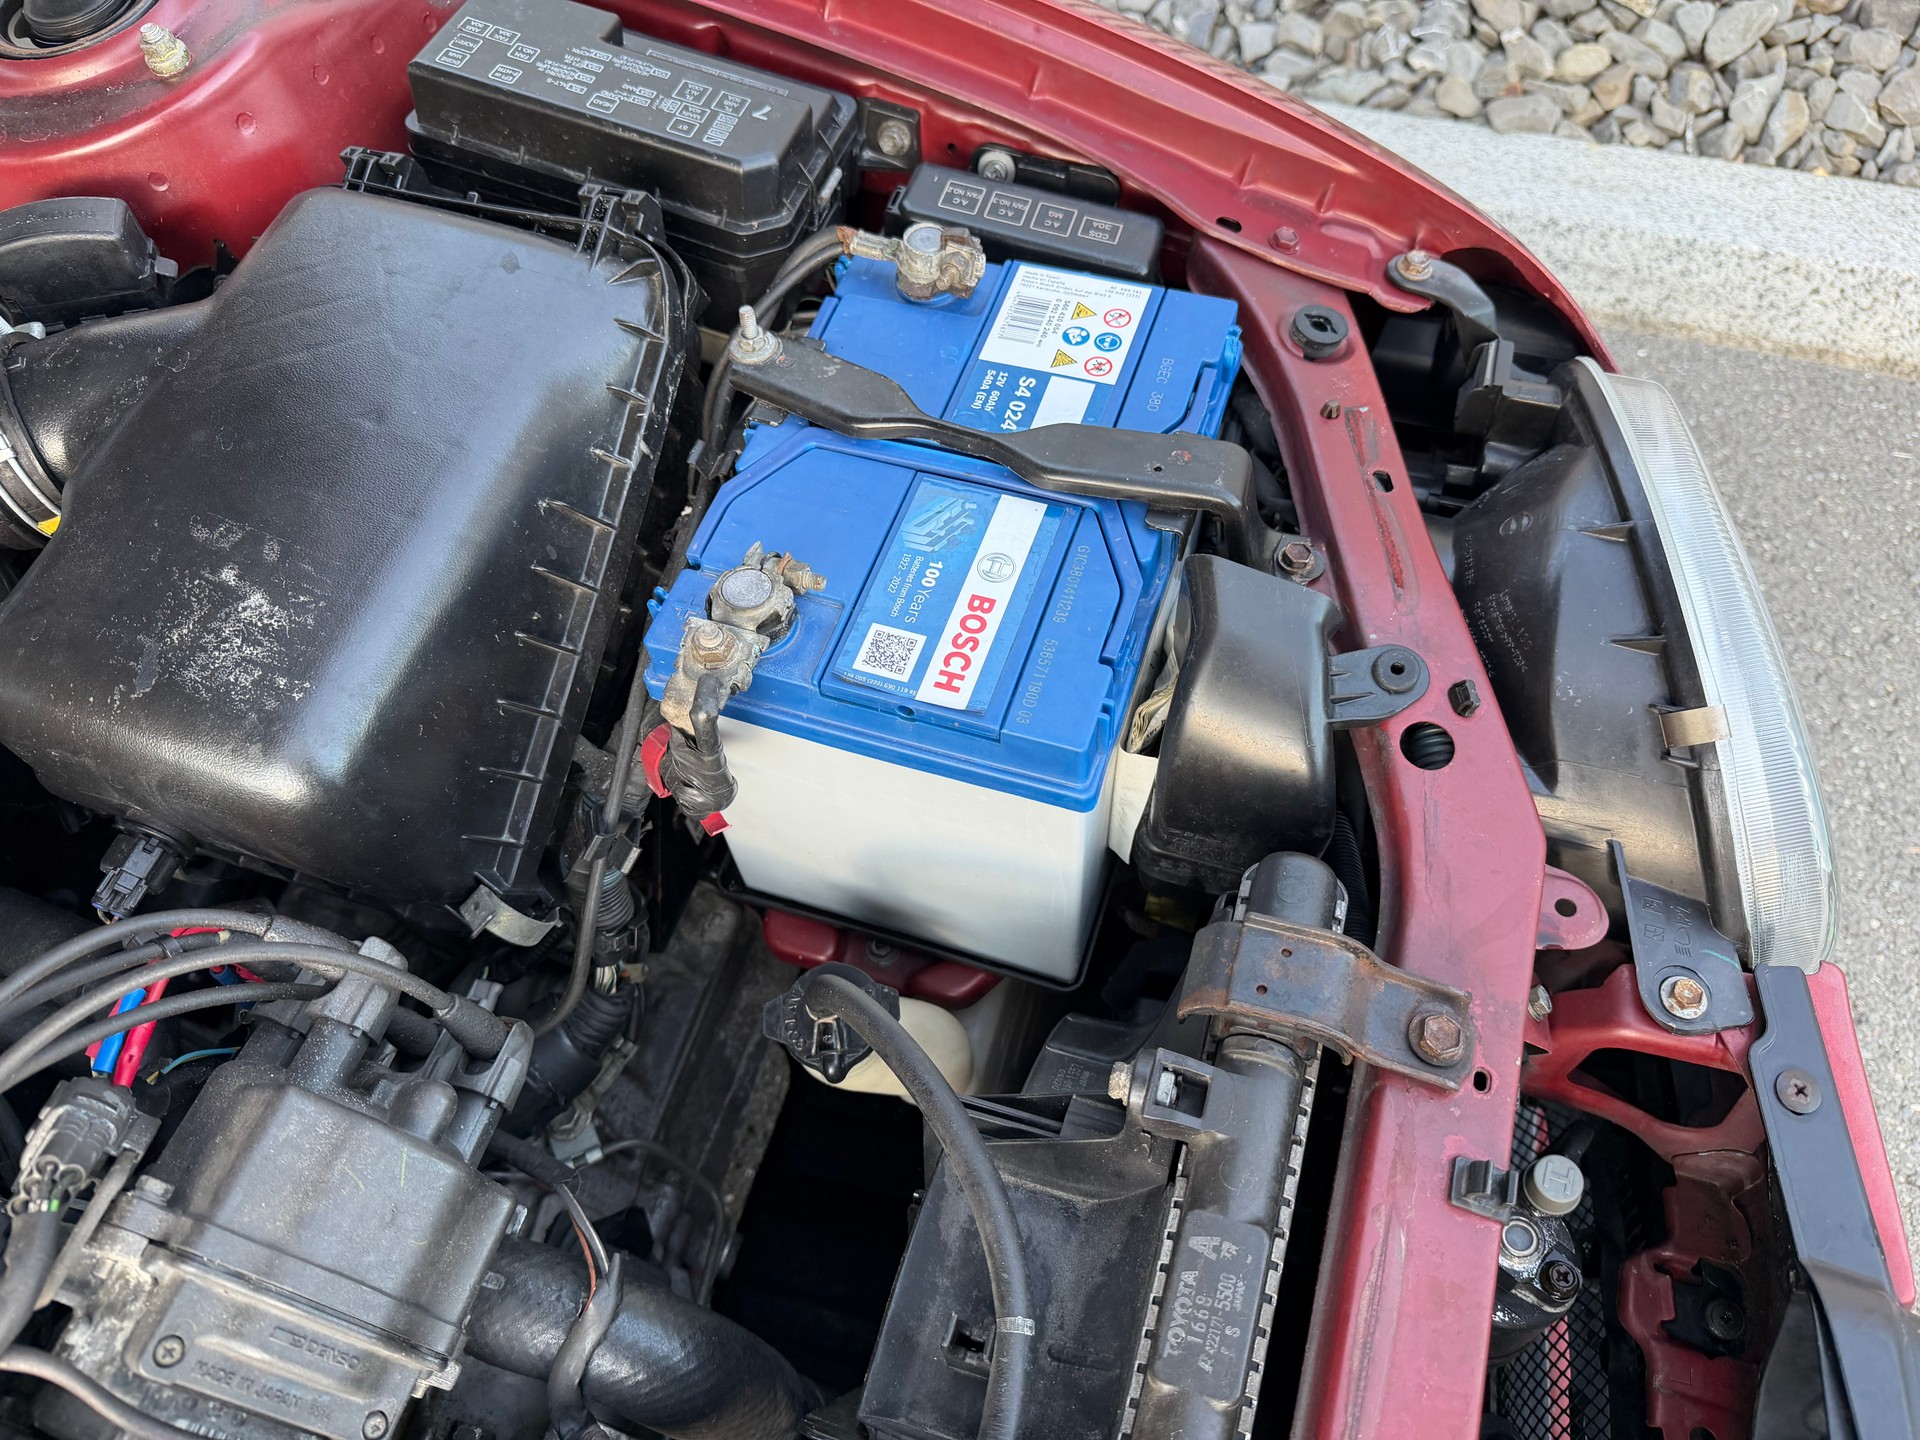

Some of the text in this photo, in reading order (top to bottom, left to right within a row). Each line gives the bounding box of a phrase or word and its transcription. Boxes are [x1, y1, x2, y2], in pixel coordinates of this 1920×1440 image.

[593, 99, 613, 108] HEAD
[682, 111, 702, 120] MAIN
[966, 192, 982, 200] FAN
[1012, 202, 1028, 211] FAN
[1048, 211, 1064, 220] MG
[1092, 221, 1112, 231] 30A
[1051, 304, 1060, 314] 092
[1052, 300, 1071, 334] 560 410 054
[1040, 327, 1050, 338] 240
[1156, 358, 1174, 384] BGEC
[971, 369, 996, 409] 540A (EN)
[984, 371, 1008, 411] 12V 60Ah
[1000, 376, 1036, 430] S4 024
[1147, 392, 1164, 411] 380
[898, 554, 912, 570] 1922
[888, 576, 901, 593] 2022
[890, 556, 924, 617] Batteries from Bosch
[934, 594, 996, 693] BOSCH
[1188, 1236, 1220, 1260] A
[1163, 1270, 1198, 1358] TOYOTA
[303, 1338, 360, 1370] DENSO
[192, 1360, 235, 1387] MADE
[255, 1385, 301, 1410] JAPAN
